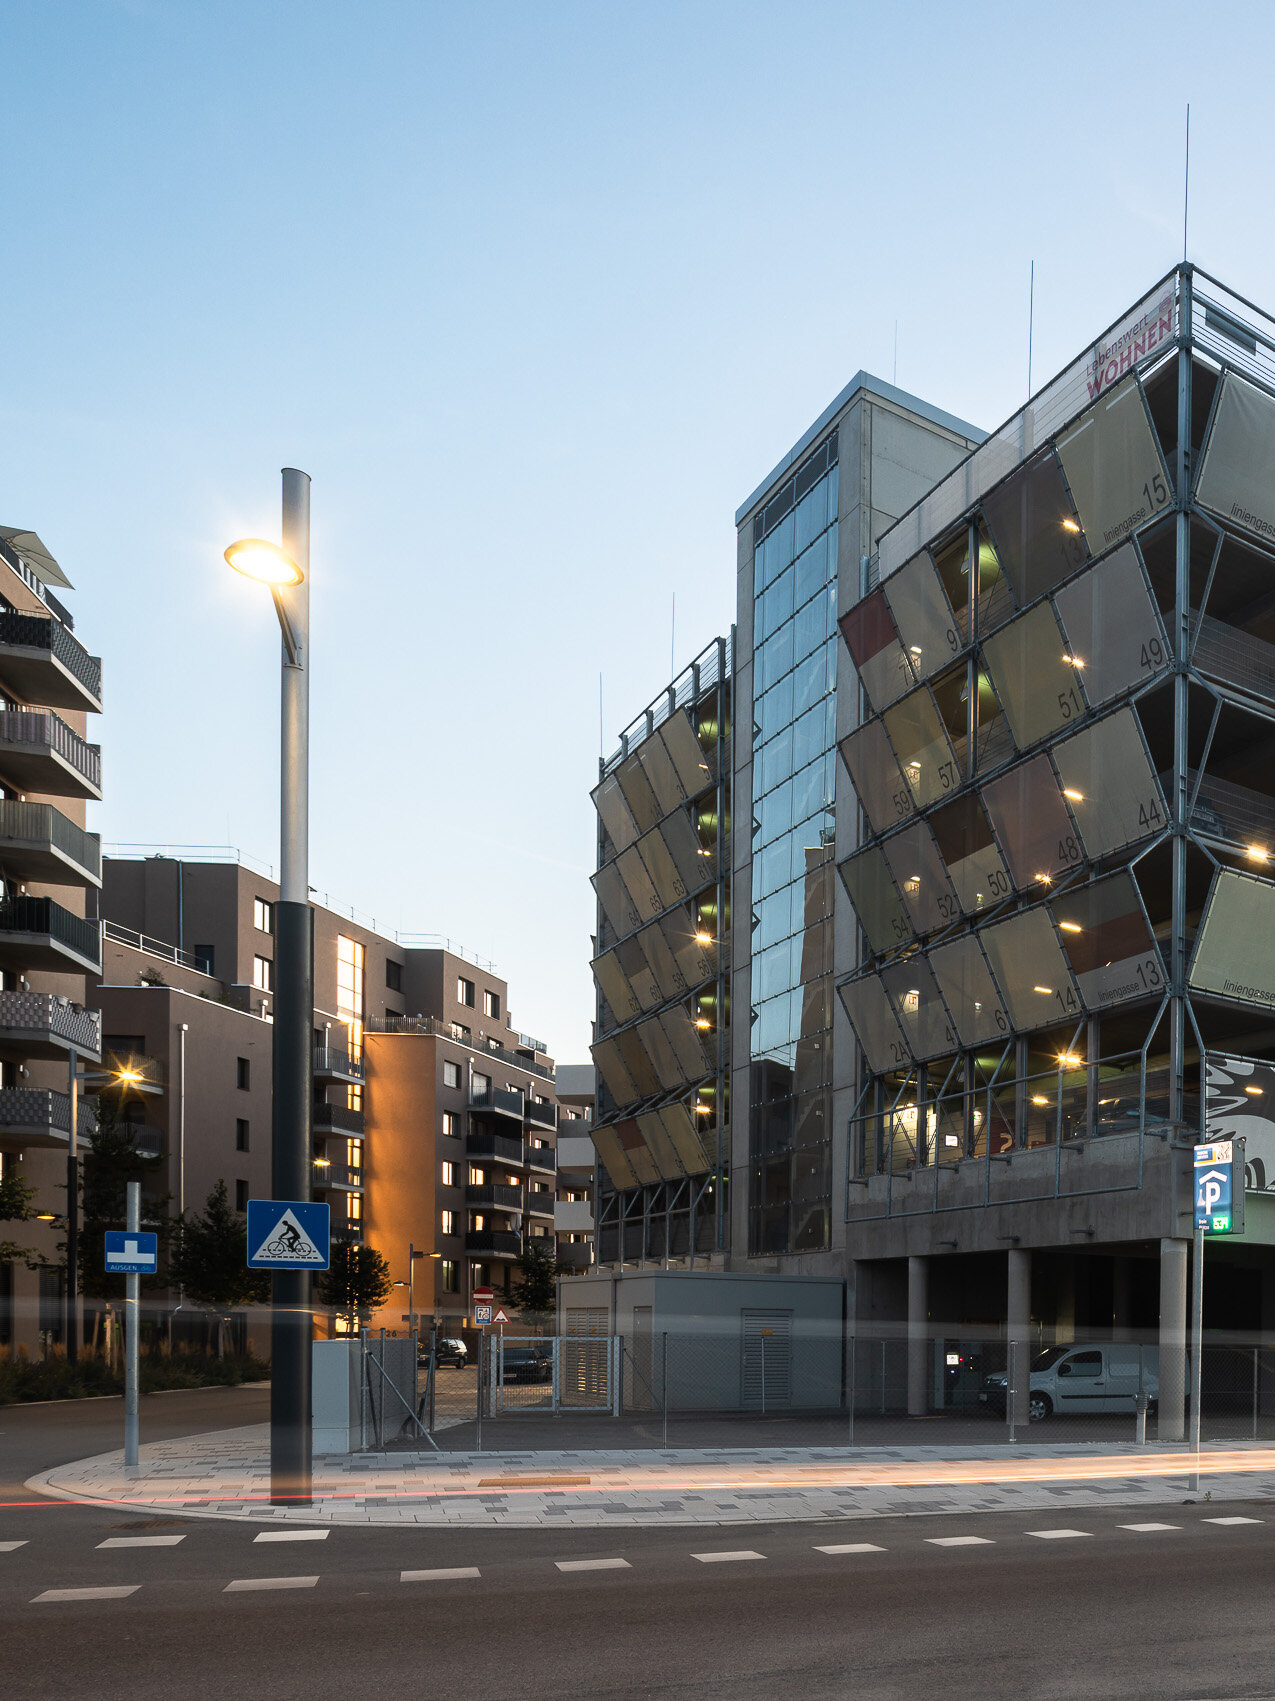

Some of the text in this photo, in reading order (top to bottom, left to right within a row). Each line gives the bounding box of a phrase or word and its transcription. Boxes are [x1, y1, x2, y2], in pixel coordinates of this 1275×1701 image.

[1086, 313, 1149, 377] Lebenswert
[1086, 308, 1173, 399] WOHNEN
[1103, 473, 1168, 543] liniengasse 15
[946, 628, 958, 653] 9
[1140, 637, 1164, 670] 49
[1058, 687, 1081, 719] 51
[938, 762, 956, 789] 57
[892, 790, 911, 815] 59
[1138, 800, 1161, 829] 44
[1058, 836, 1080, 863] 48
[988, 870, 1008, 896] 50
[937, 894, 958, 919] 52
[892, 917, 909, 941] 54
[1136, 958, 1160, 989] 13
[1056, 986, 1077, 1012] 14
[1223, 978, 1275, 1002] liniengasse
[994, 1009, 1007, 1031] 6
[945, 1024, 955, 1046] 4
[1206, 1181, 1221, 1215] P
